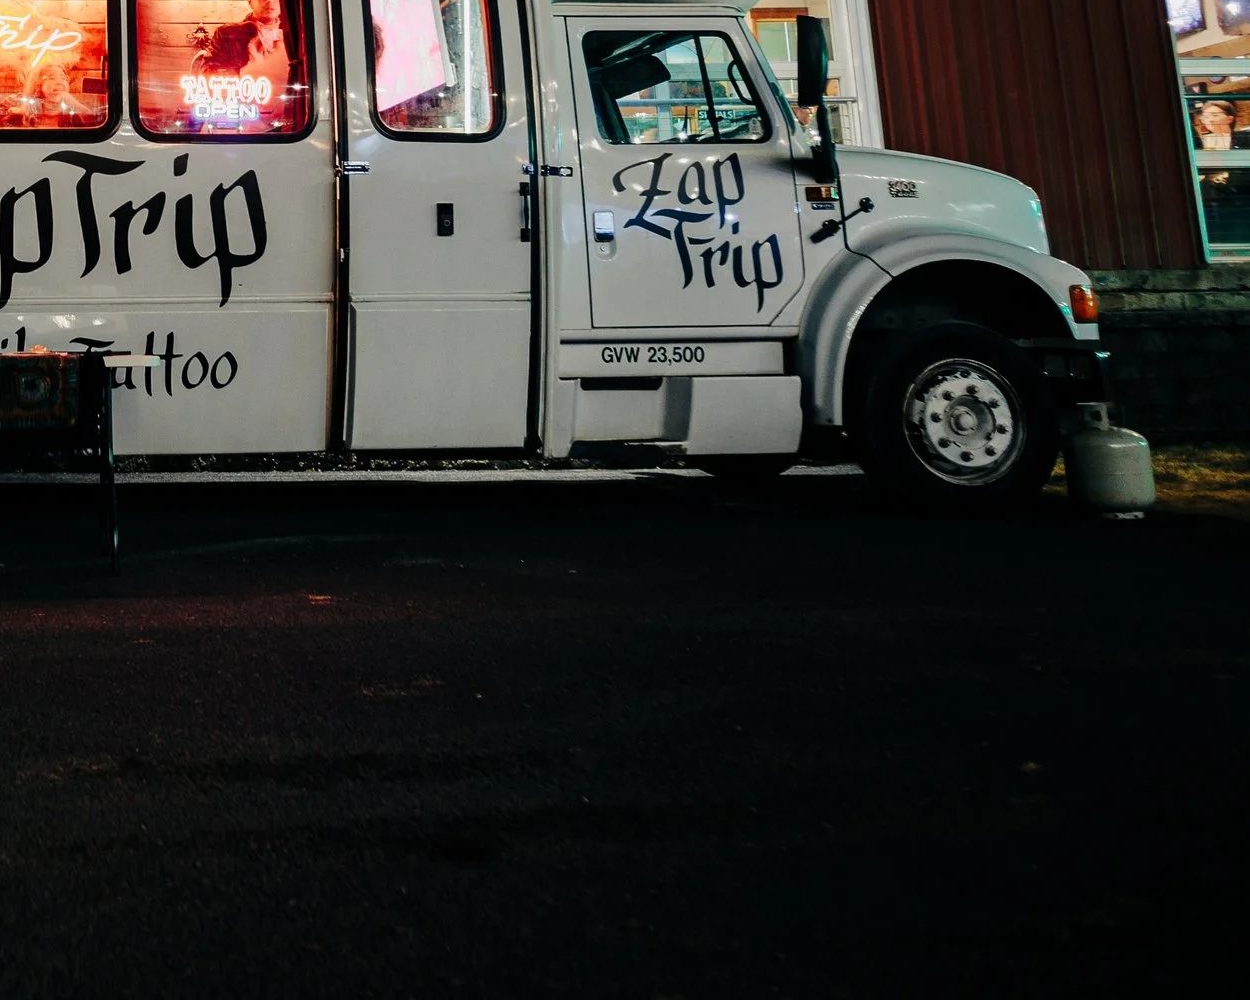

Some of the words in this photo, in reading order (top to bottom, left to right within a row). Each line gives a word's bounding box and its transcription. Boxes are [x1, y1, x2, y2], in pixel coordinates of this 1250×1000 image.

[180, 75, 272, 105] TATTOO
[194, 103, 257, 120] OPEN
[612, 152, 745, 240] Zap
[651, 209, 784, 314] Trip
[601, 346, 640, 363] GVW
[647, 346, 705, 366] 23,500
